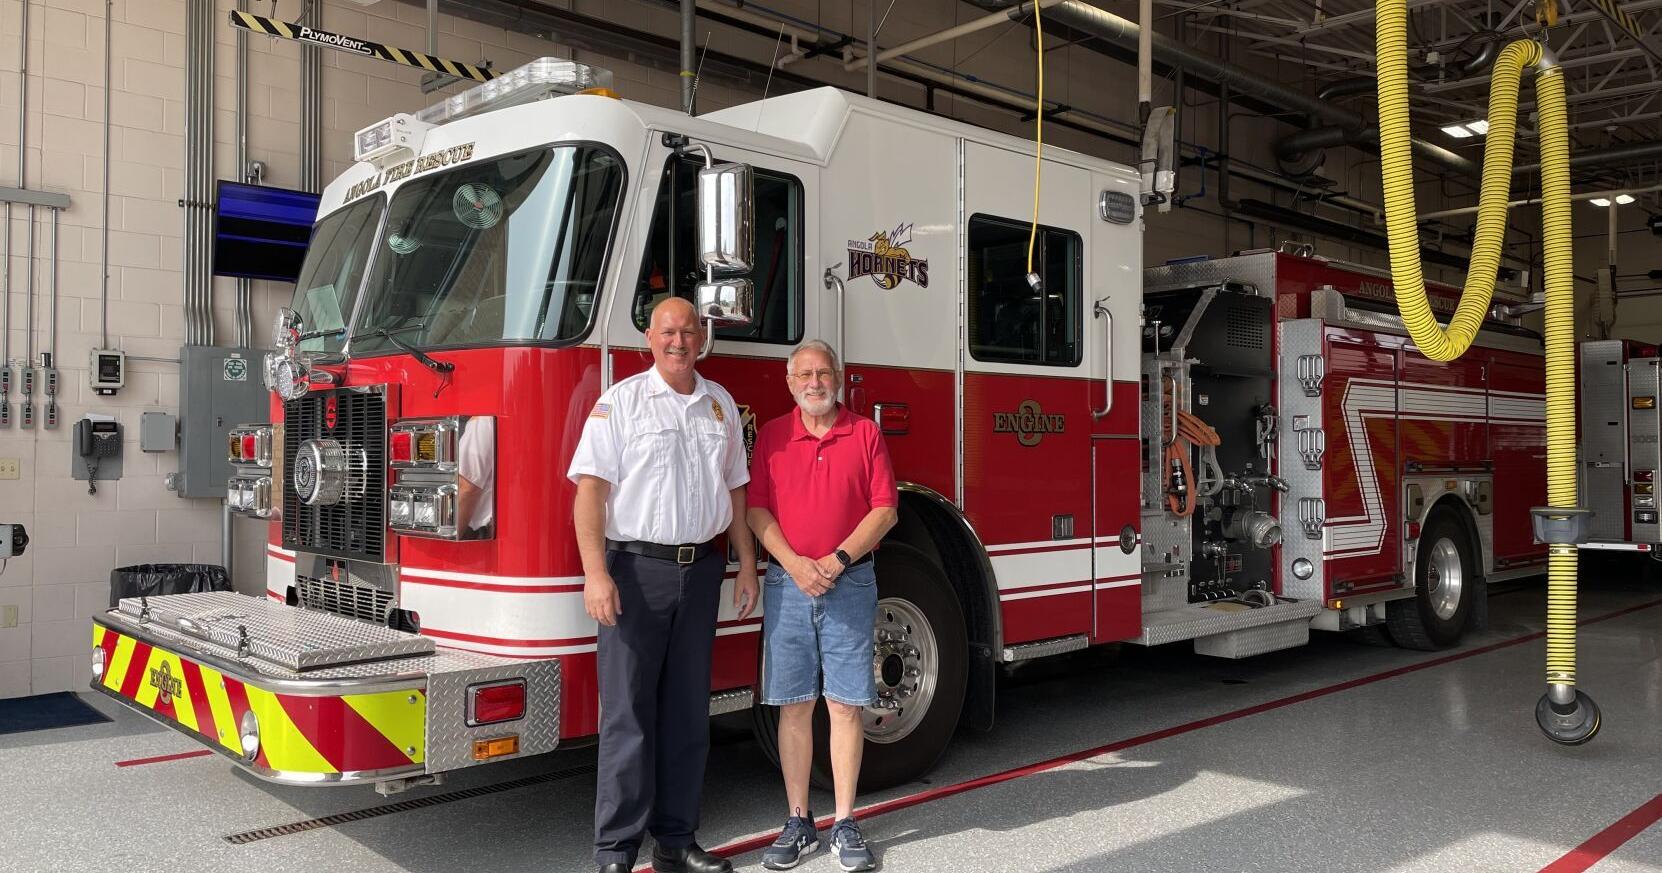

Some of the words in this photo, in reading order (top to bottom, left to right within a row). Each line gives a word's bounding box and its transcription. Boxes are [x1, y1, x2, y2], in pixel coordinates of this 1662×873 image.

[343, 173, 382, 204] ANGOLA
[383, 160, 415, 186] FIRE
[414, 141, 476, 175] RESCUE
[848, 240, 873, 250] ANGOLA
[847, 248, 928, 289] HORNETS
[1359, 280, 1395, 299] ANGOL
[993, 412, 1065, 433] ENGINE
[150, 667, 182, 699] ENGINE
